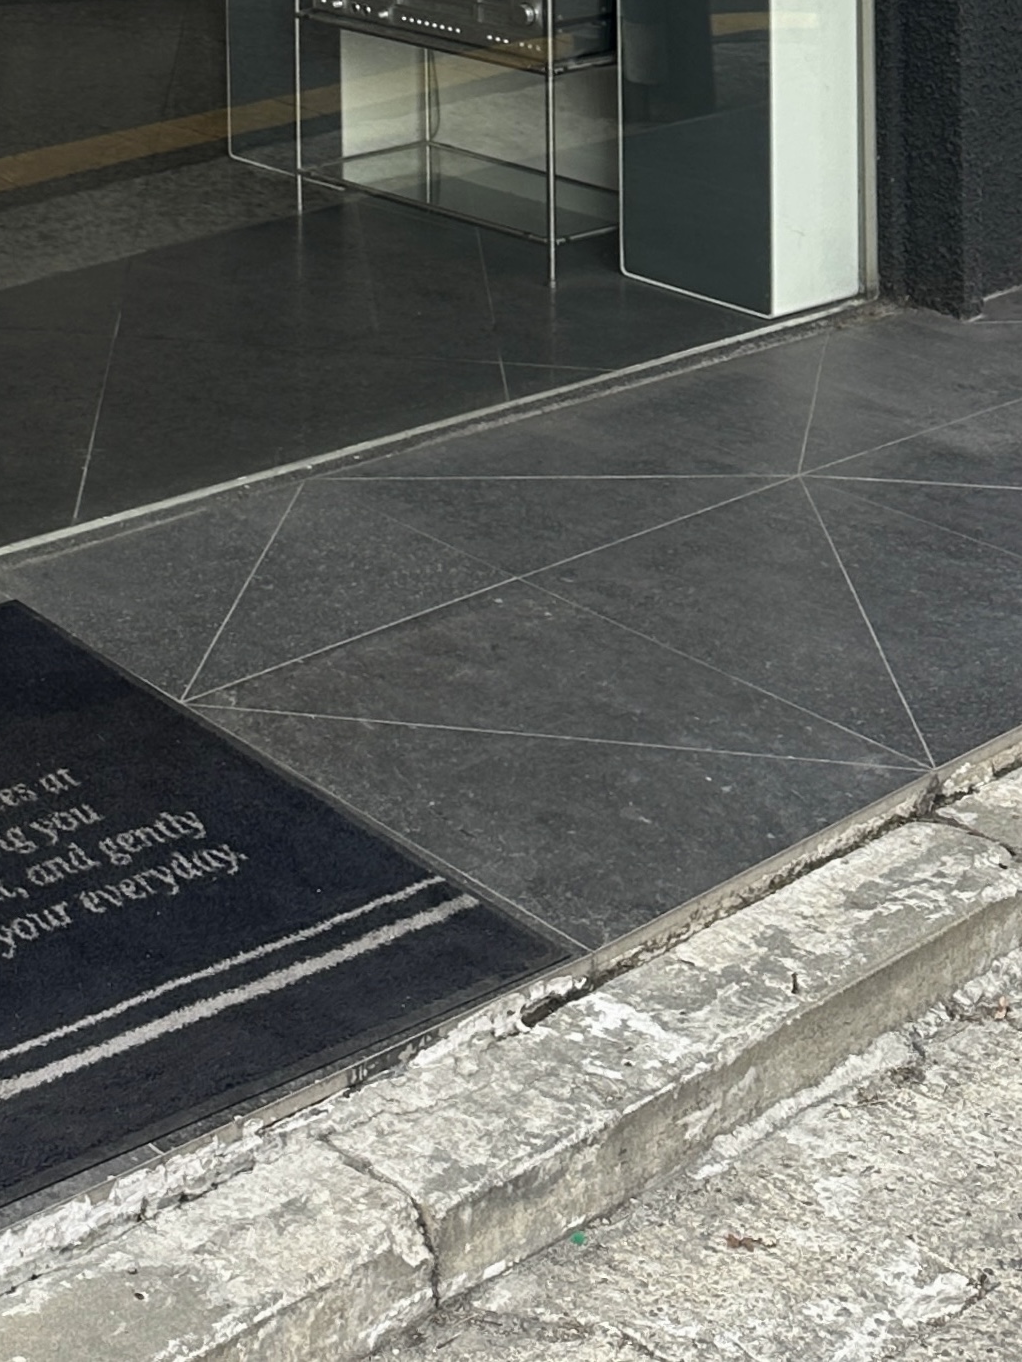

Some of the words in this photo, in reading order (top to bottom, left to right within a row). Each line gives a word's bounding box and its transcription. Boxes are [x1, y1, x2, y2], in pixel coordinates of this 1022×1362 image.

[40, 768, 82, 796] at
[27, 842, 103, 887] and
[98, 810, 208, 866] gently
[29, 803, 105, 846] you
[79, 843, 250, 913] everyday.
